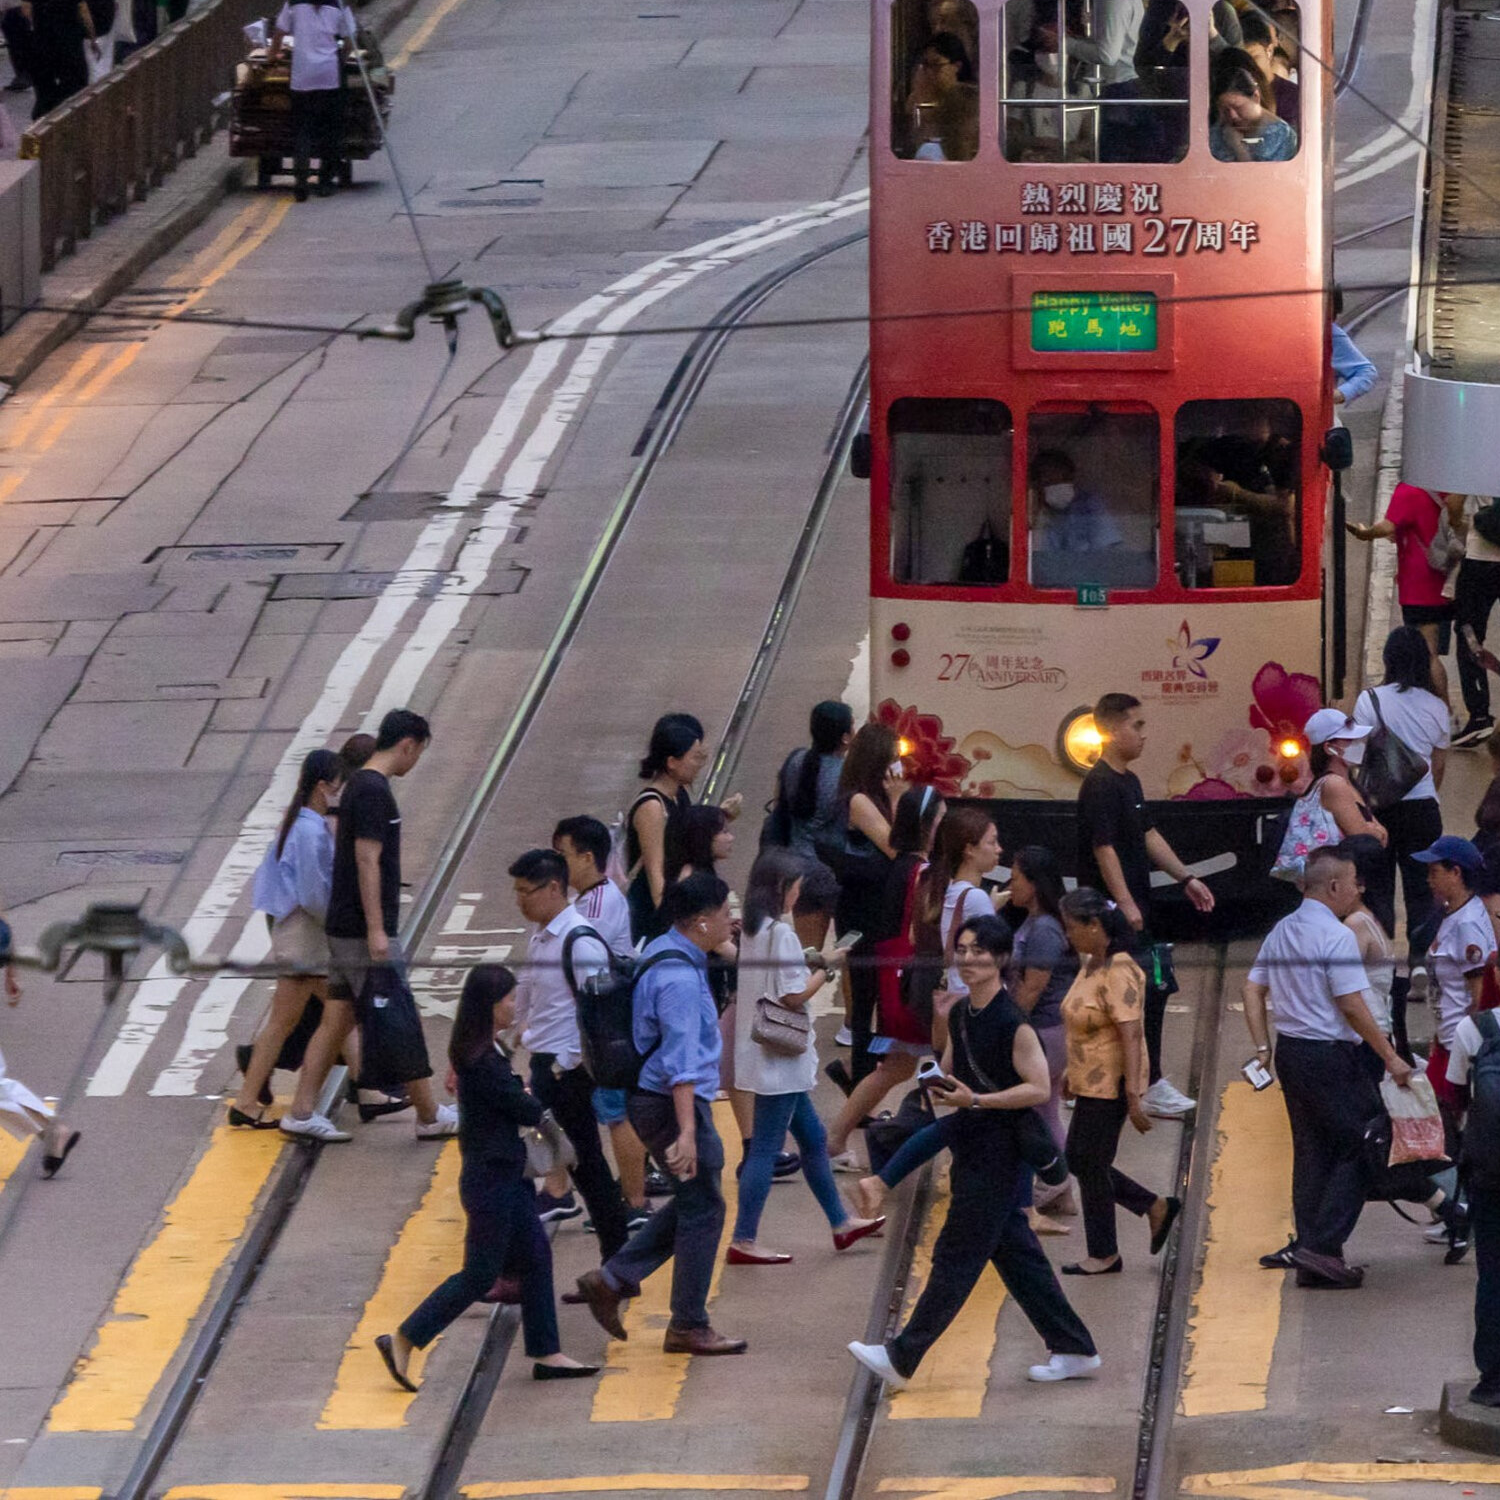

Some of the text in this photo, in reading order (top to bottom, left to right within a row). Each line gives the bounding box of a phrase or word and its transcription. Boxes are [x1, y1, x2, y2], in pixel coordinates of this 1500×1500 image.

[1020, 183, 1162, 213] 熱烈慶祝
[925, 219, 1260, 254] 香港回歸祖國27周年
[1034, 293, 1150, 315] Happy Valley
[1047, 318, 1141, 338] 跑馬地
